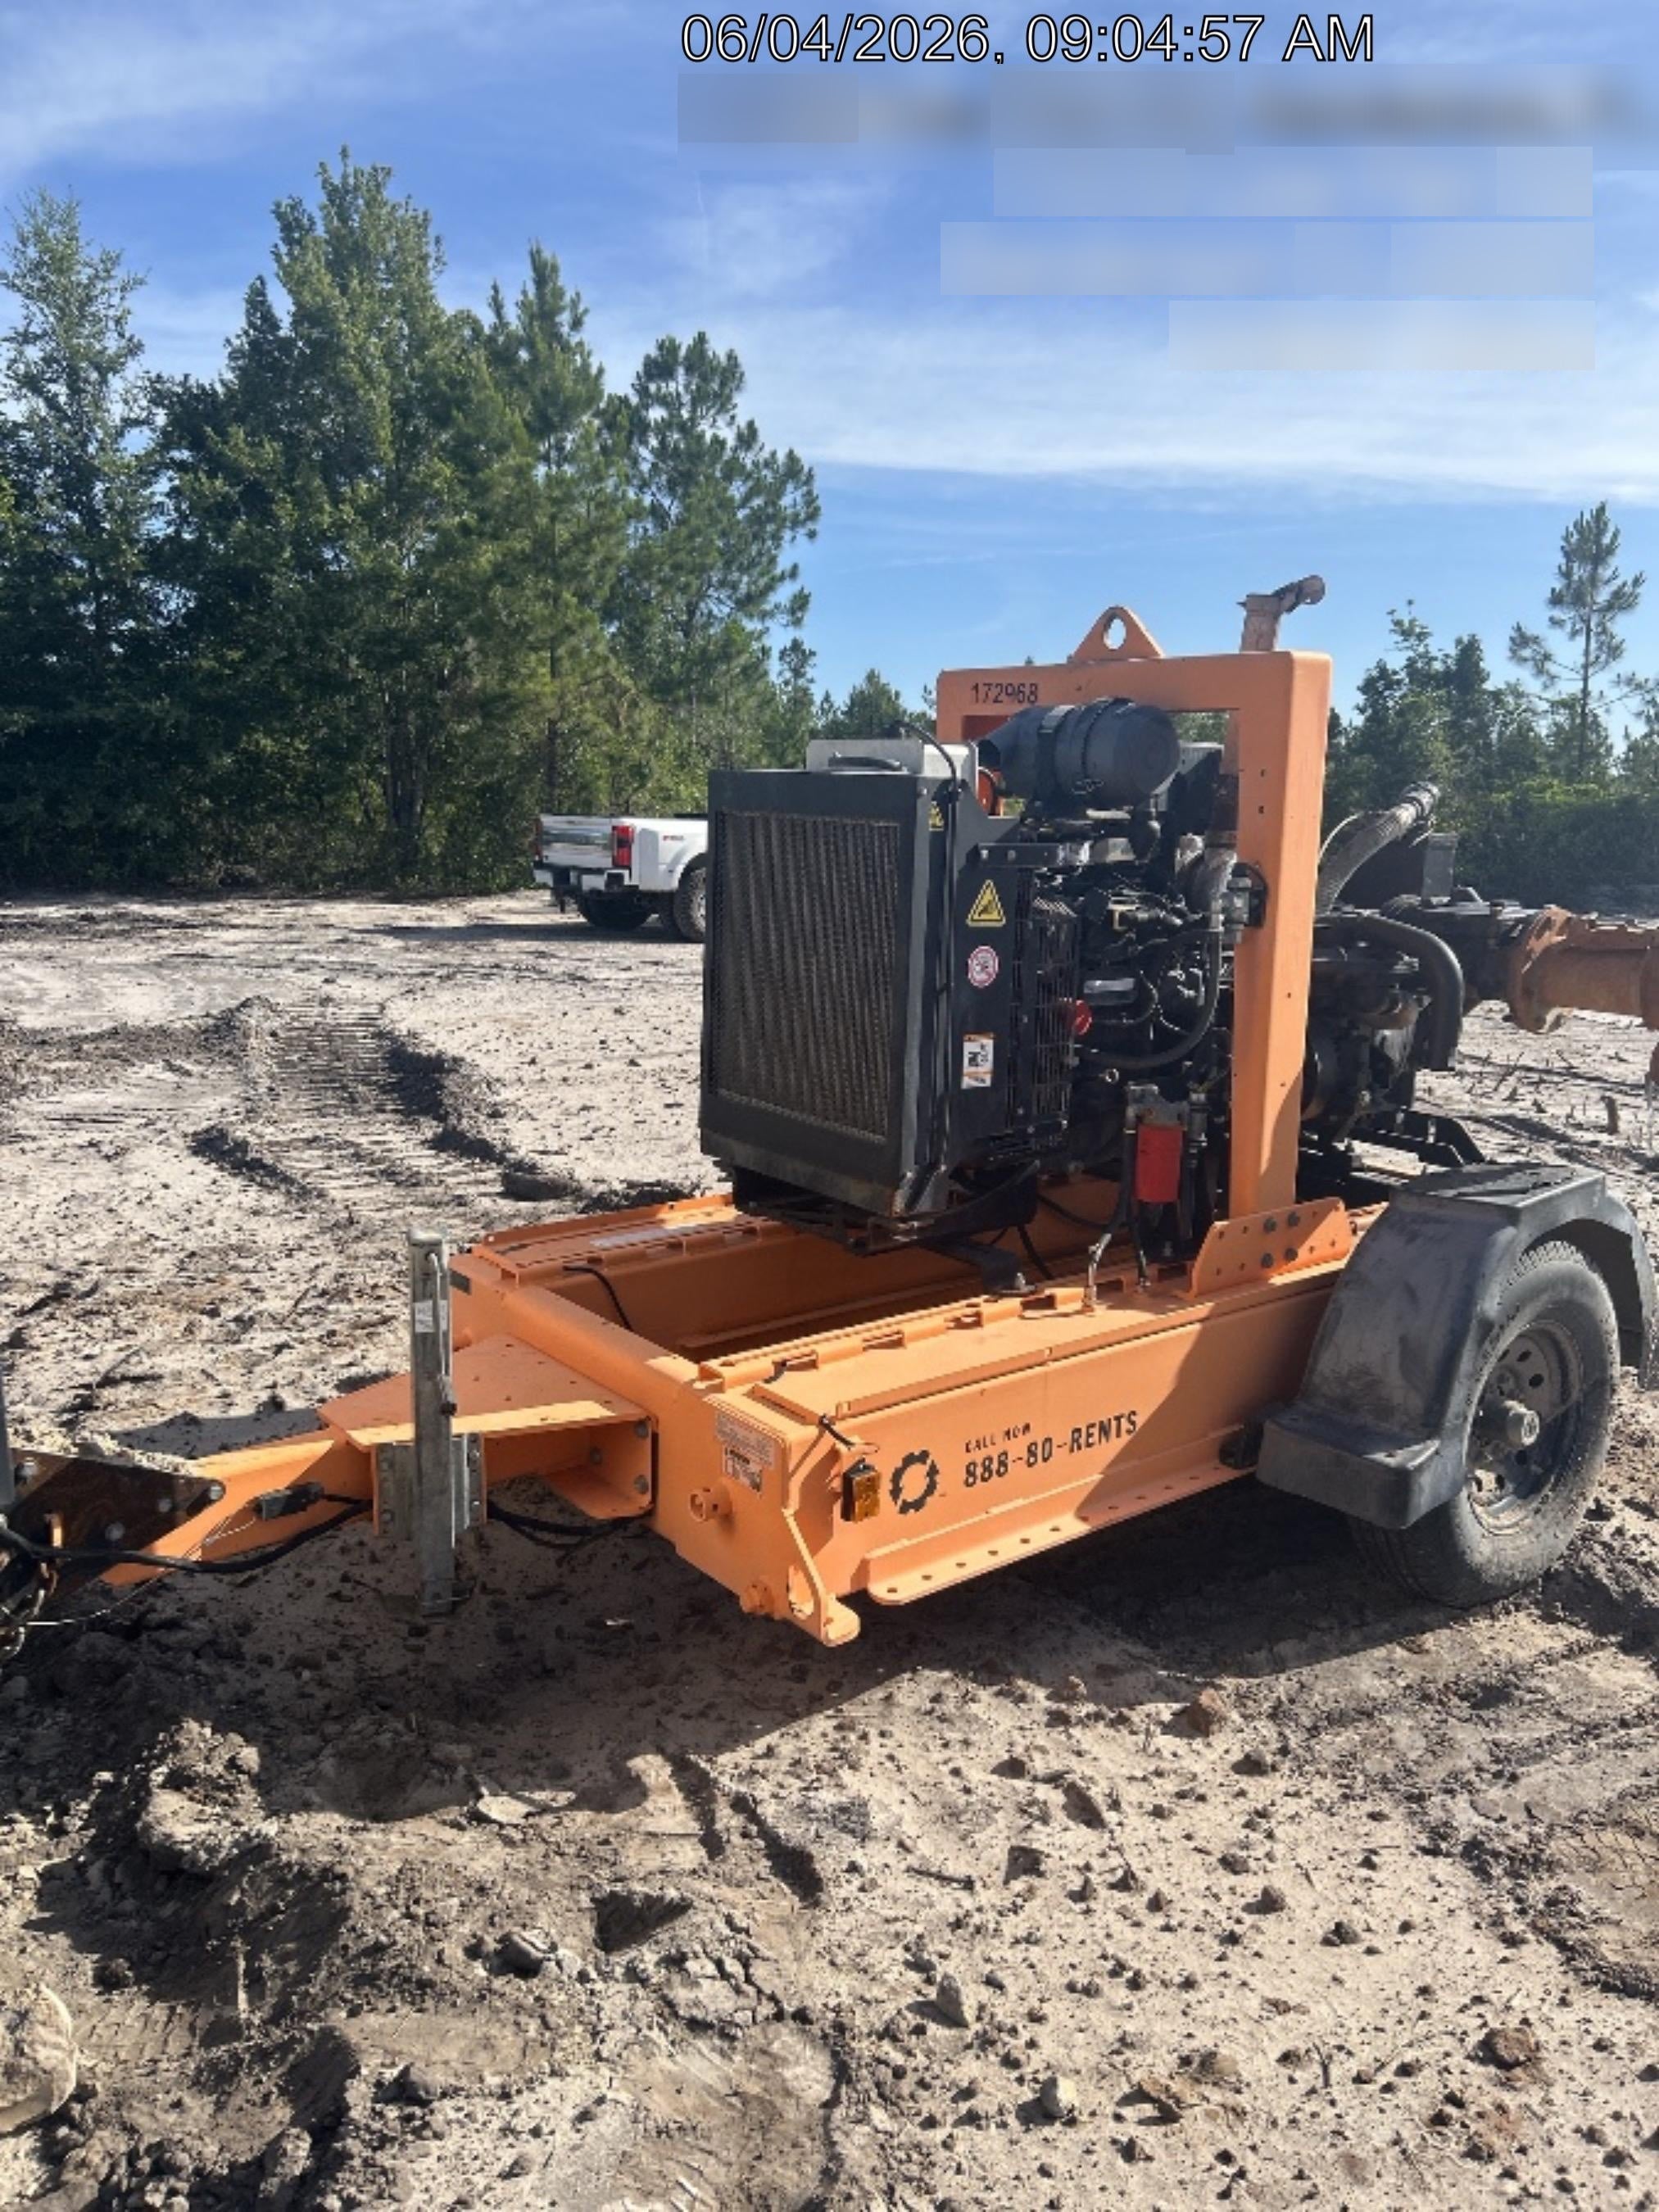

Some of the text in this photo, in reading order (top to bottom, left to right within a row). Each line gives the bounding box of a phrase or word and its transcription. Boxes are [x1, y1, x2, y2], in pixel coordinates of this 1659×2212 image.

[971, 682, 1039, 704] 172968
[963, 1410, 1137, 1488] 888-80-RENTS
[965, 1422, 1031, 1453] CALL NOW
